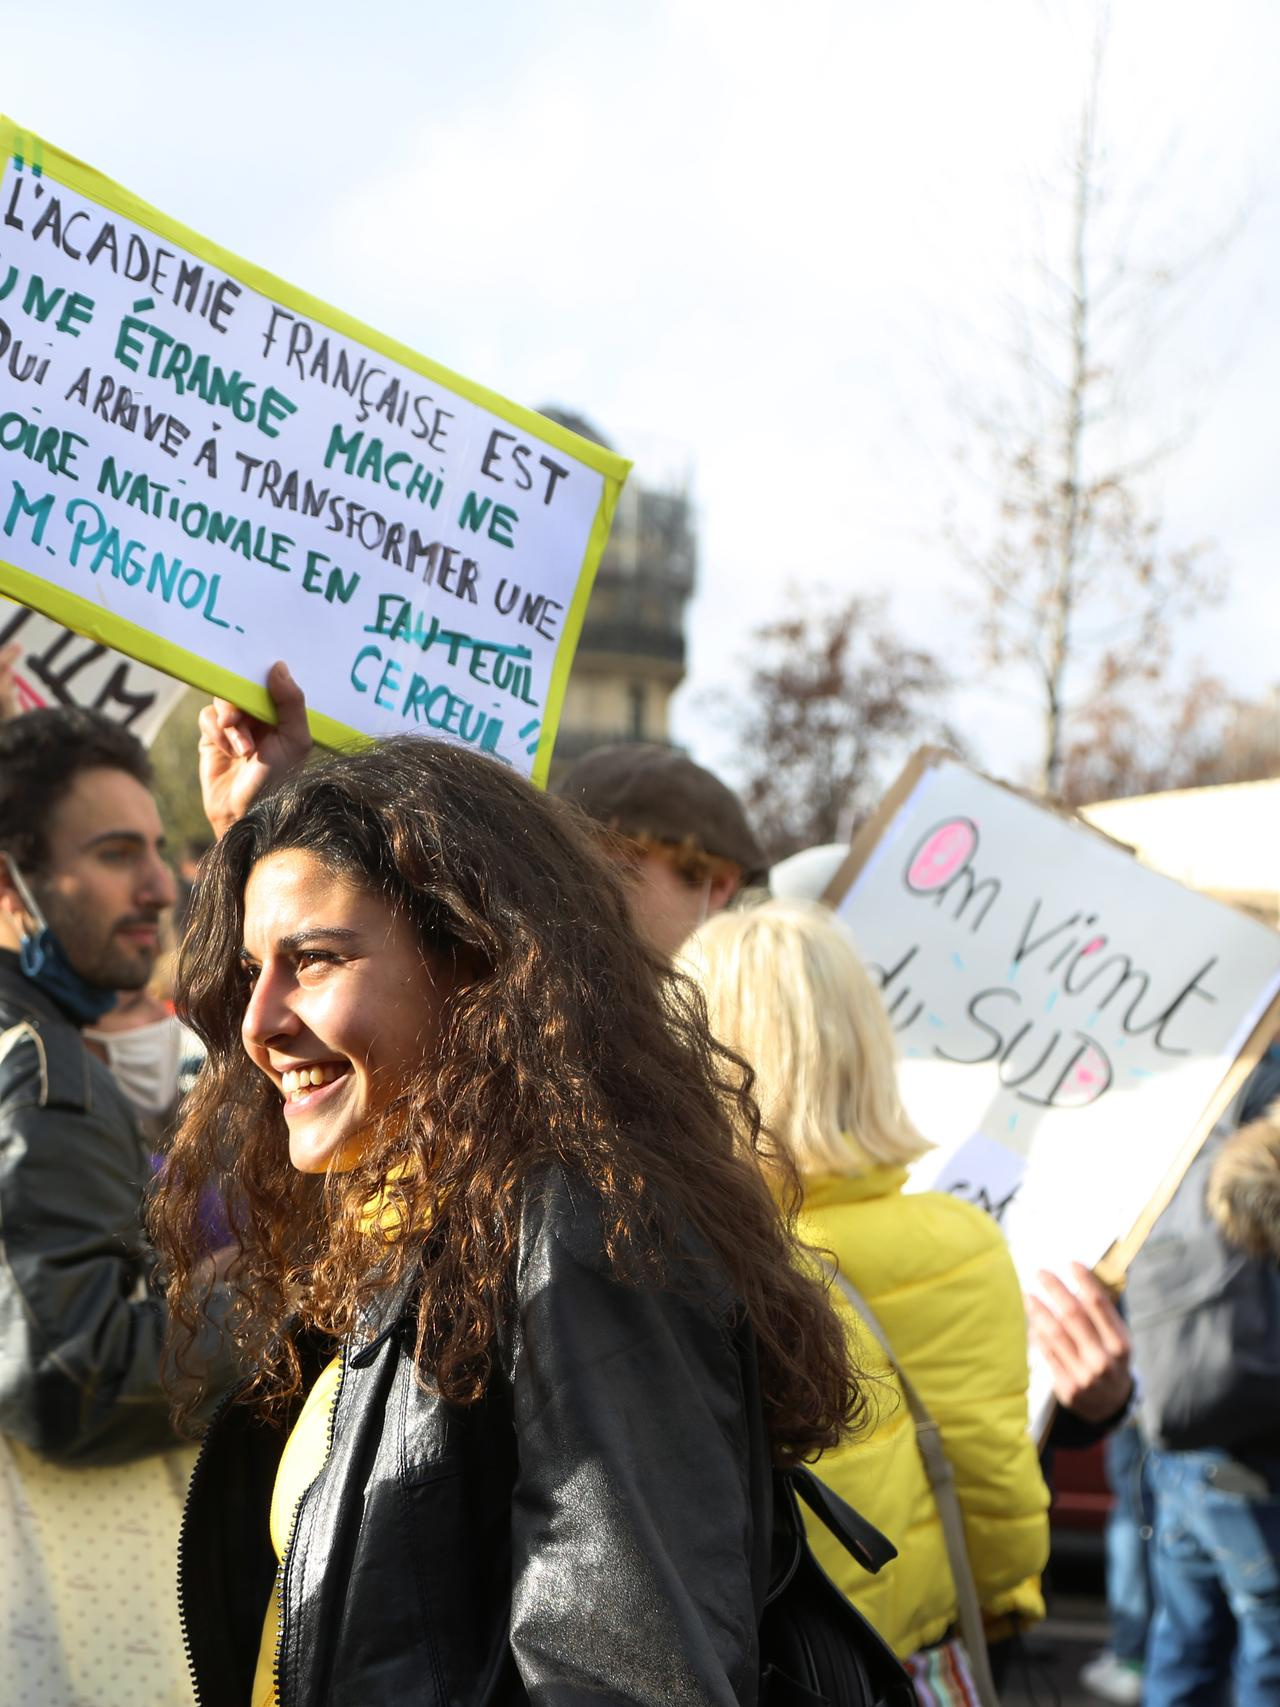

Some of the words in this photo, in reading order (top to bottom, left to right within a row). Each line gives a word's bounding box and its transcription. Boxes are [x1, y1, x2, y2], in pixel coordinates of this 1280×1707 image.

[115, 297, 298, 439] ÉTRANGE
[262, 303, 455, 452] FRANÇAISE
[480, 428, 570, 505] EST
[235, 451, 478, 605] TRANSFORMER
[494, 578, 564, 641] UNE
[302, 550, 361, 604] EN
[932, 985, 1113, 1108] SUD
